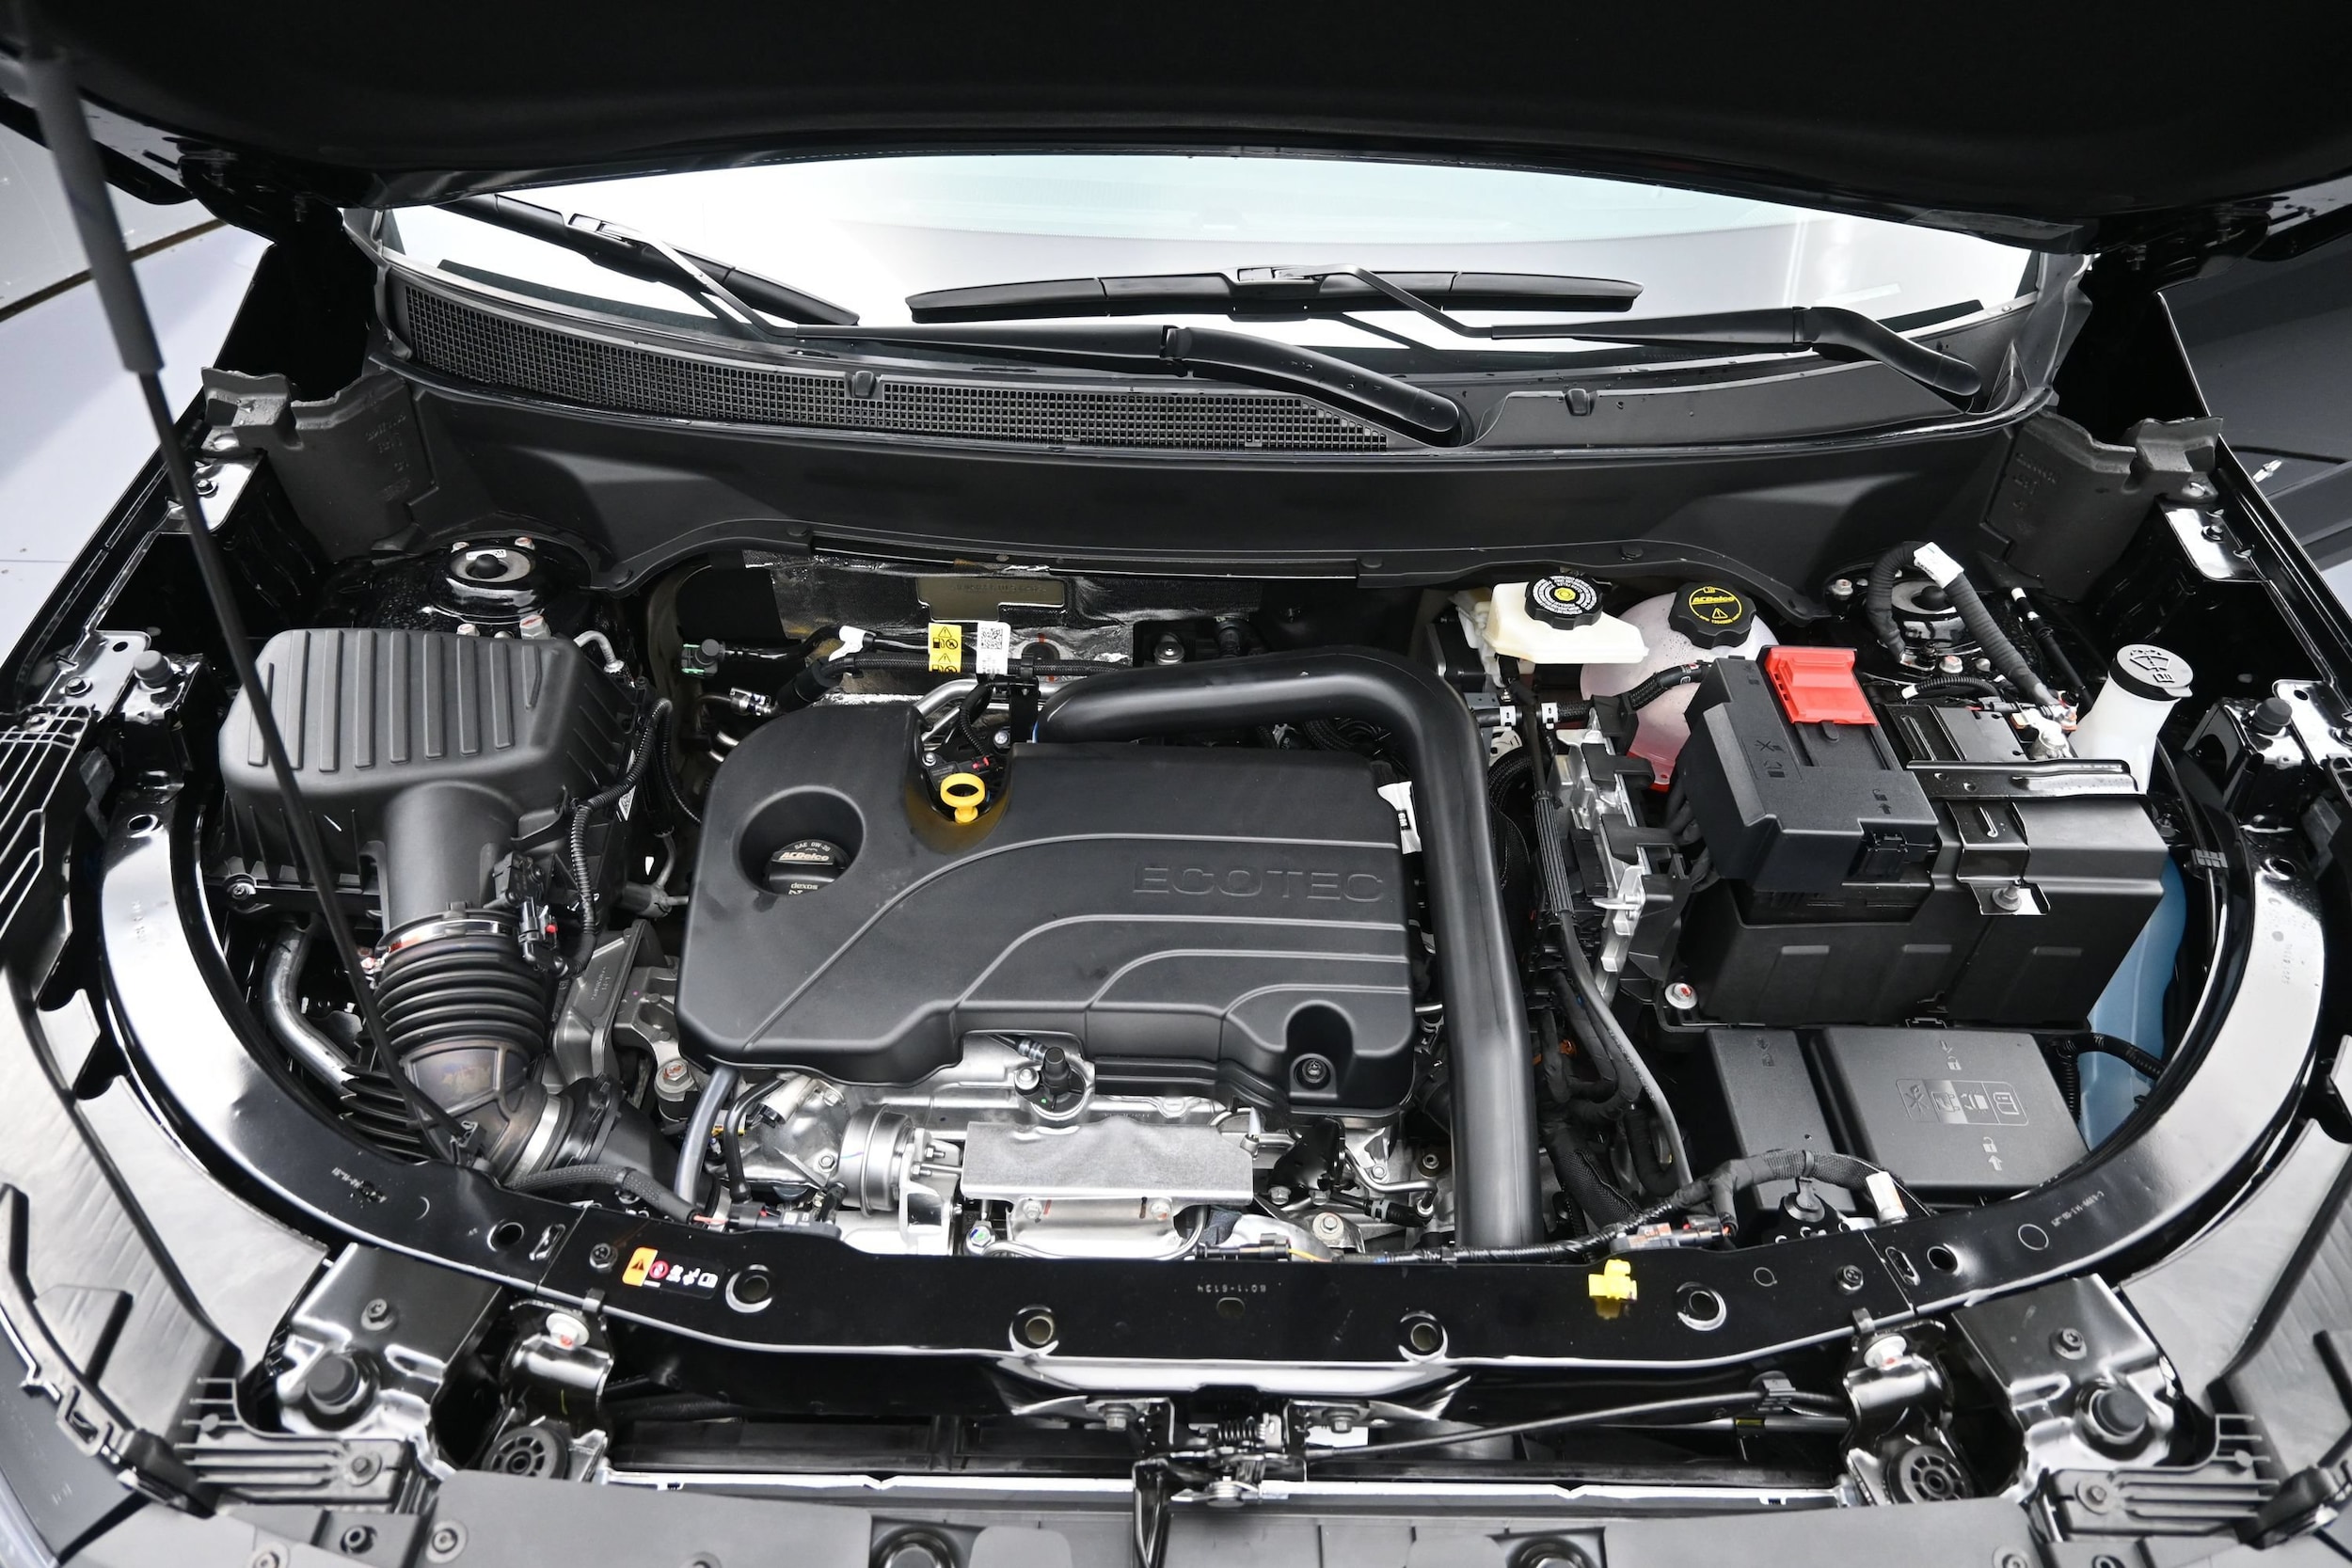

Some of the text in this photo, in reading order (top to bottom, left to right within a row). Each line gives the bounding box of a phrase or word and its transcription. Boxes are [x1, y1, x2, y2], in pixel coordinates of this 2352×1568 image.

[1398, 813, 1408, 827] GM
[794, 841, 832, 852] SAE 0W-20
[778, 851, 830, 862] ACDelco
[1133, 866, 1384, 903] ECOTEC
